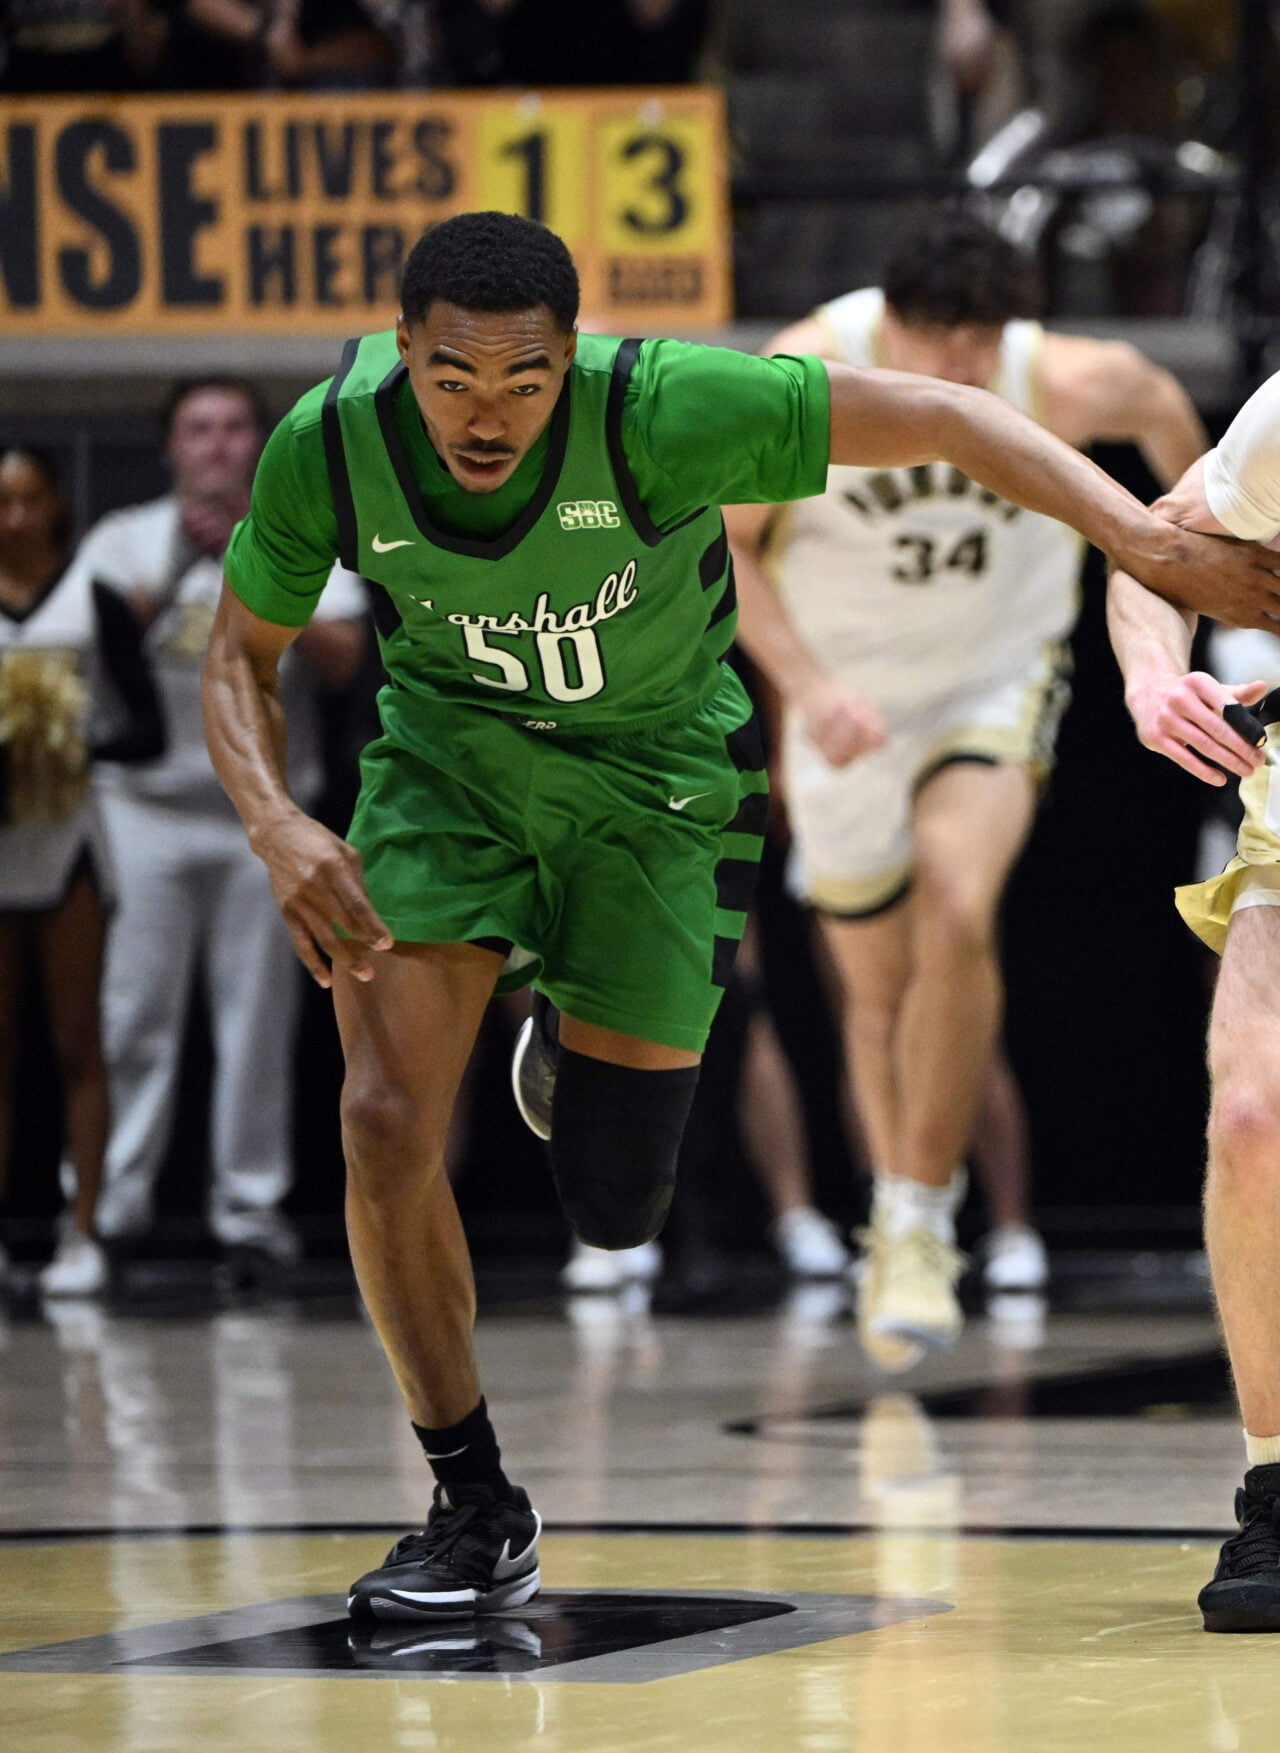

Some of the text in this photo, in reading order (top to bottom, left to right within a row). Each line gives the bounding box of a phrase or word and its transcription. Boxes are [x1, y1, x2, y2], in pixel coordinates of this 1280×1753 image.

[245, 116, 455, 204] LIVES
[247, 223, 436, 308] HER
[557, 500, 621, 531] SBC
[892, 526, 989, 582] 34
[407, 557, 639, 635] arshall
[462, 624, 607, 704] 50
[522, 719, 558, 731] ERD
